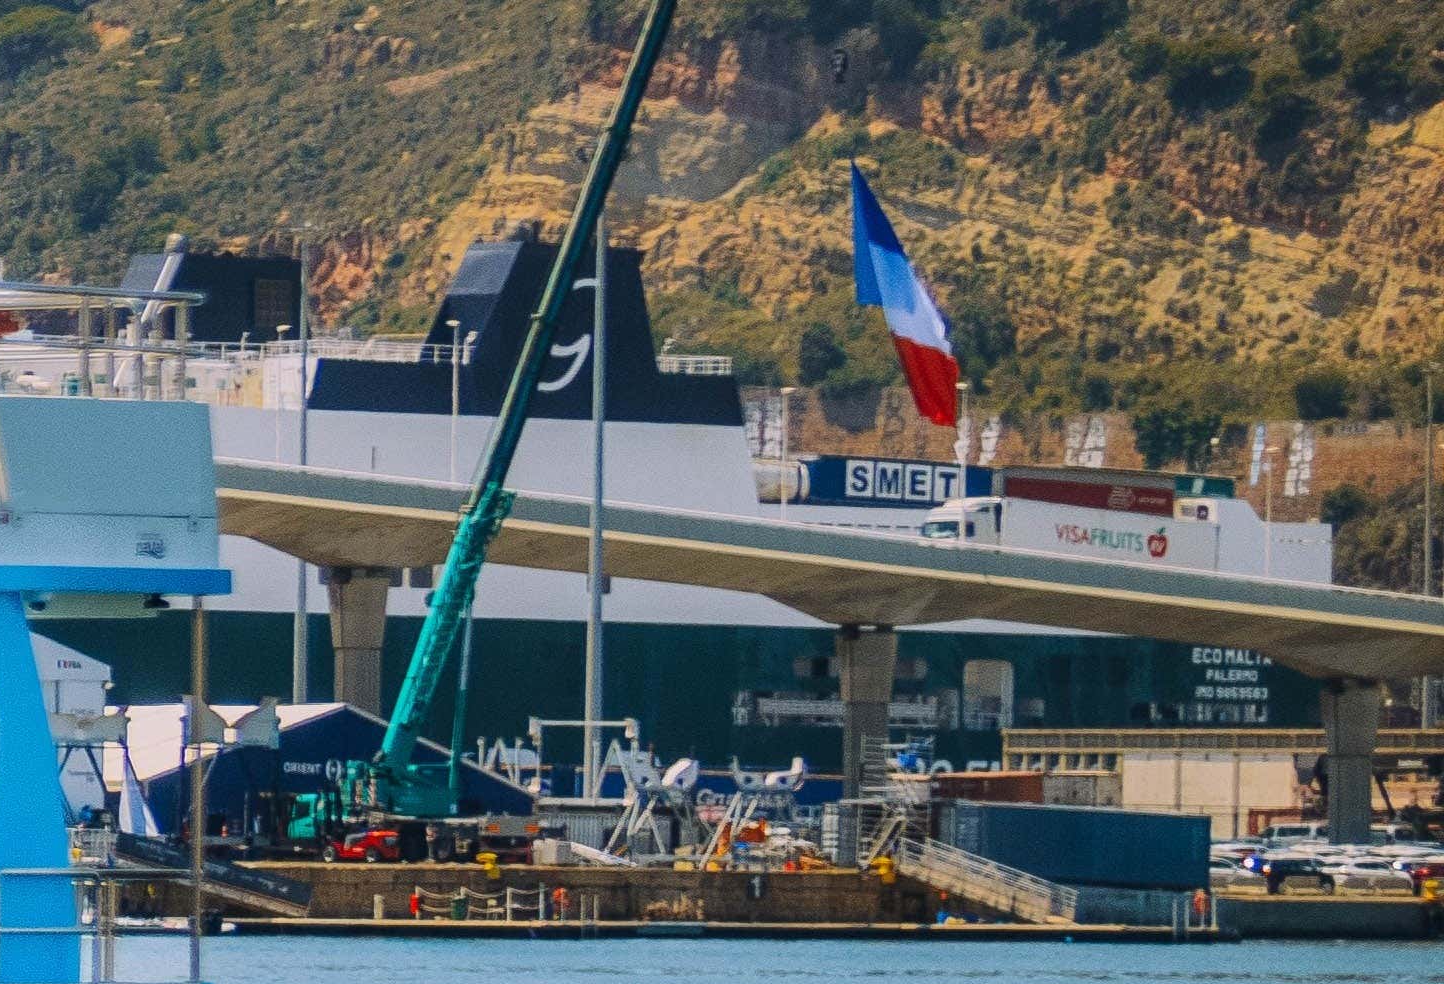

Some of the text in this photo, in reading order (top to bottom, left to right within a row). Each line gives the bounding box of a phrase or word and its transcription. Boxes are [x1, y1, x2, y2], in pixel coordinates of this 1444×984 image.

[848, 463, 958, 498] SMET
[1054, 522, 1144, 553] VISAFRUITS
[1192, 647, 1222, 664] ECO
[1205, 669, 1259, 682] PALERMO
